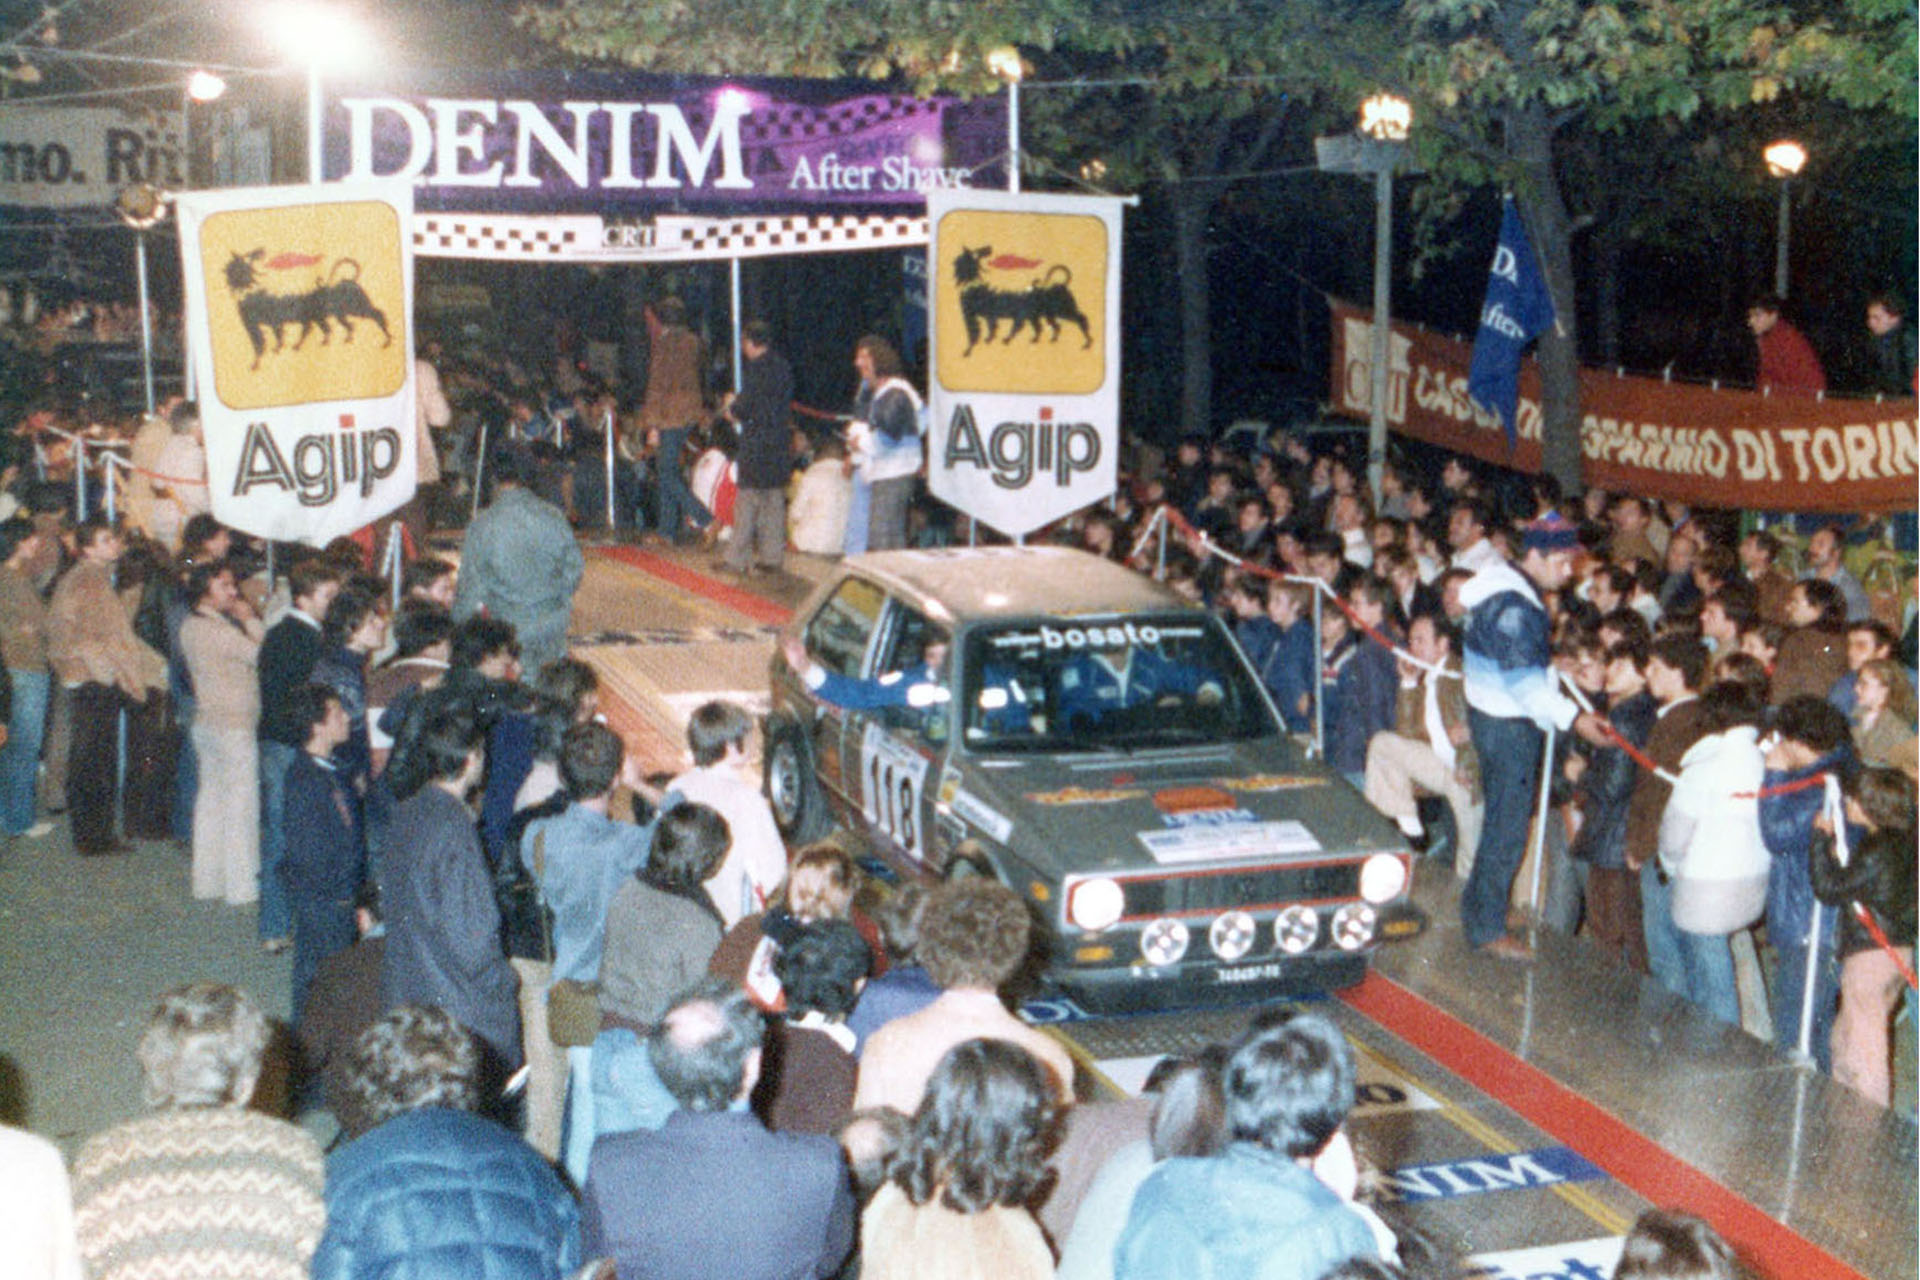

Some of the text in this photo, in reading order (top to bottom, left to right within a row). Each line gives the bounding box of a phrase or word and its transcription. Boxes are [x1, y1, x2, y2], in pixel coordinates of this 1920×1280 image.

[342, 98, 754, 188] DENIM
[790, 153, 972, 192] After Shave
[232, 413, 402, 508] Agip
[943, 404, 1102, 490] Agip
[1580, 415, 1730, 479] SPARMIO
[1732, 429, 1783, 481] DI
[1040, 622, 1160, 649] bosato
[870, 755, 914, 849] 118
